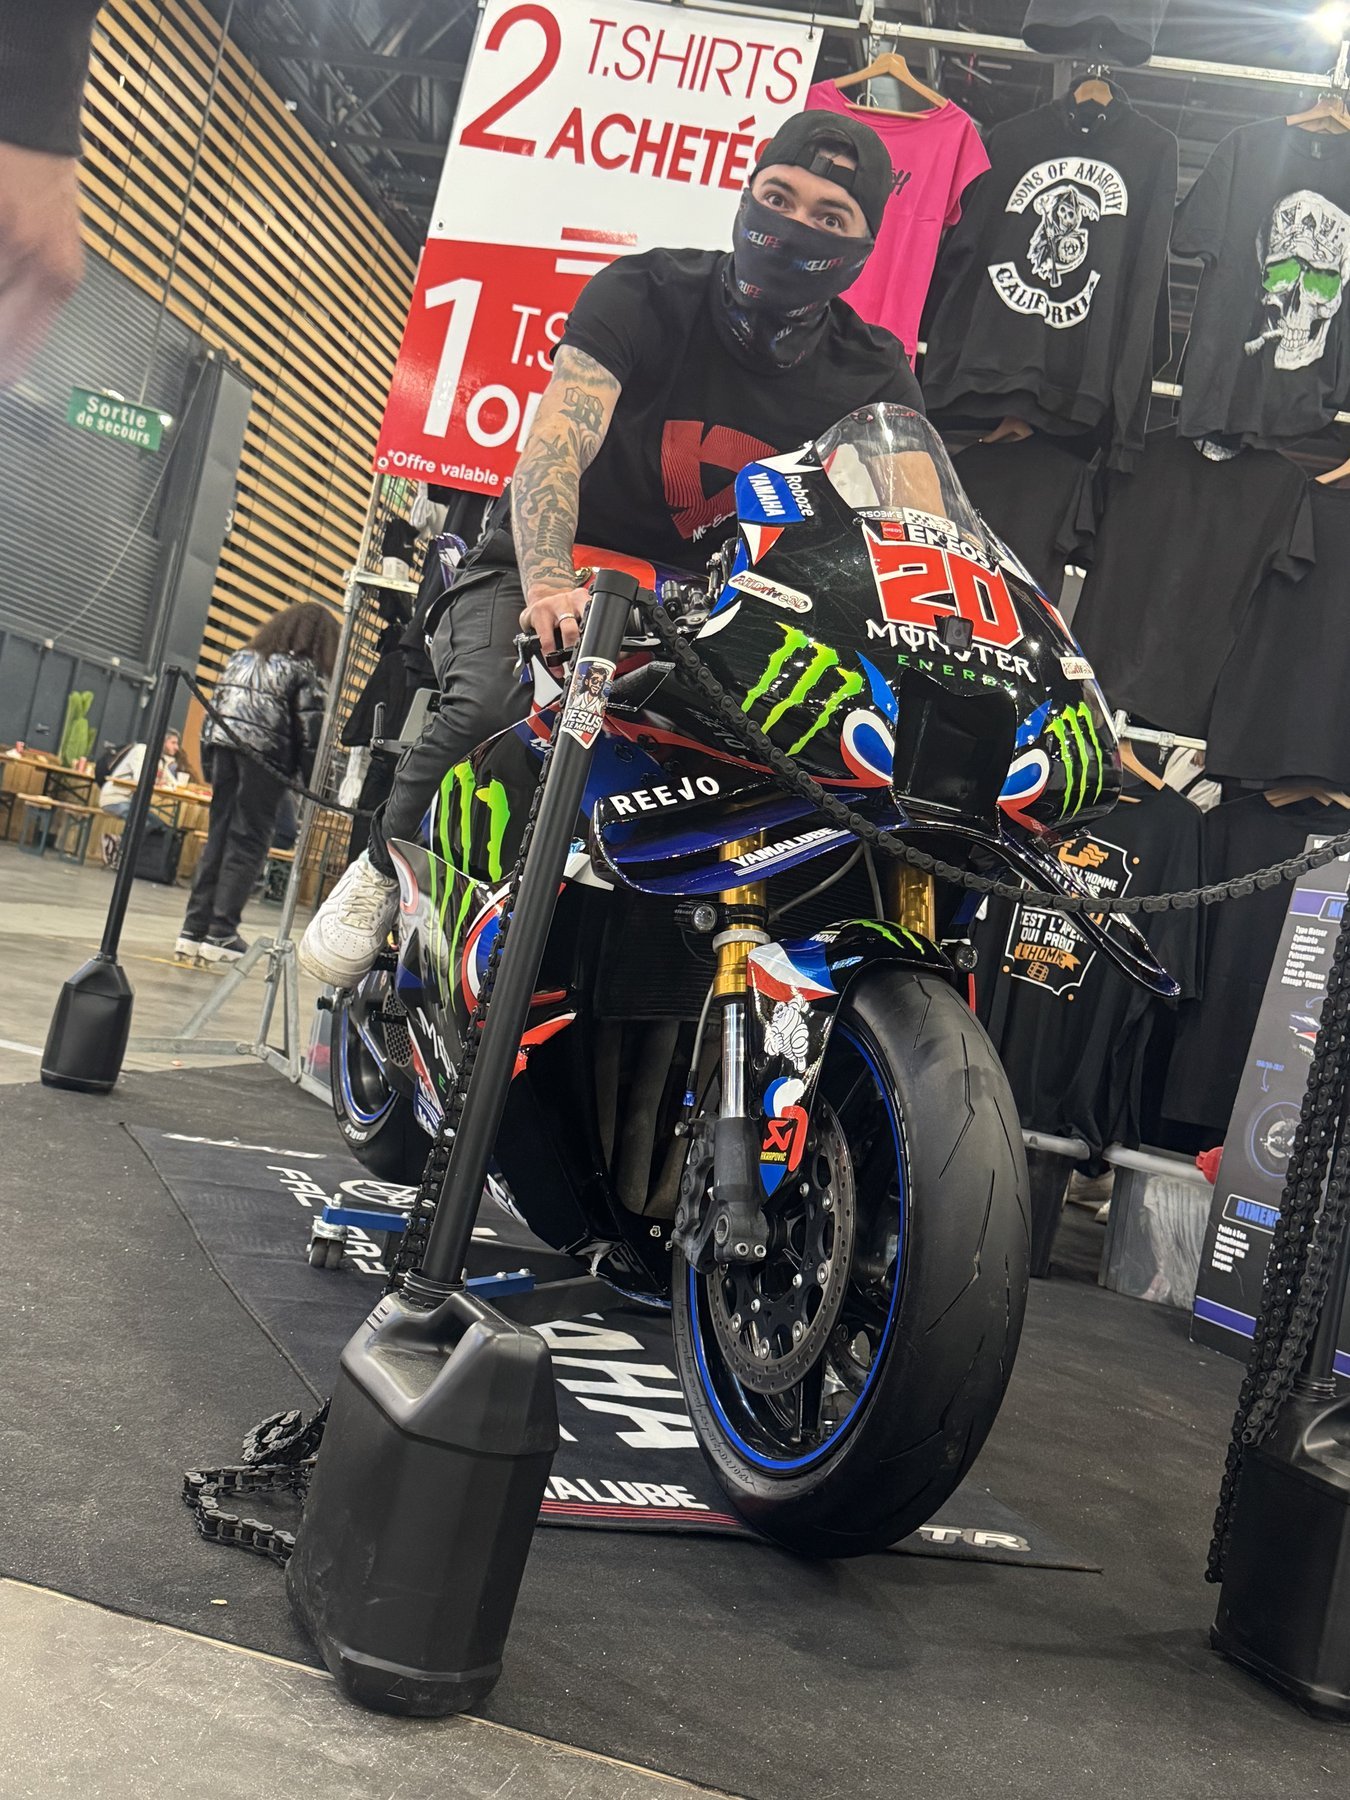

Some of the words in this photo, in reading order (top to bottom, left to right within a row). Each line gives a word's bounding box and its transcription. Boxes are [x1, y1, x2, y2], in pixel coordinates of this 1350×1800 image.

[459, 3, 562, 158] 2
[587, 17, 803, 105] T.SHIRTS
[545, 107, 772, 191] ACHETÉ
[1011, 171, 1044, 207] SONS
[1048, 162, 1068, 179] OF
[1074, 162, 1123, 212] ANARCHY
[422, 277, 483, 438] 1
[76, 411, 94, 427] de
[96, 418, 150, 445] secours
[86, 396, 147, 428] Sortie
[440, 462, 499, 486] valable
[748, 472, 786, 518] YAMAHA
[785, 475, 815, 518] Roboze
[907, 524, 991, 569] ENEOS
[862, 520, 1024, 650] 20
[897, 654, 1015, 691] ENERGY
[566, 721, 575, 729] LE
[575, 723, 595, 734] MANS
[609, 776, 720, 816] REEVO
[730, 827, 839, 868] YAMALUBE
[1021, 925, 1040, 943] QUI
[543, 1475, 711, 1511] ALUBE
